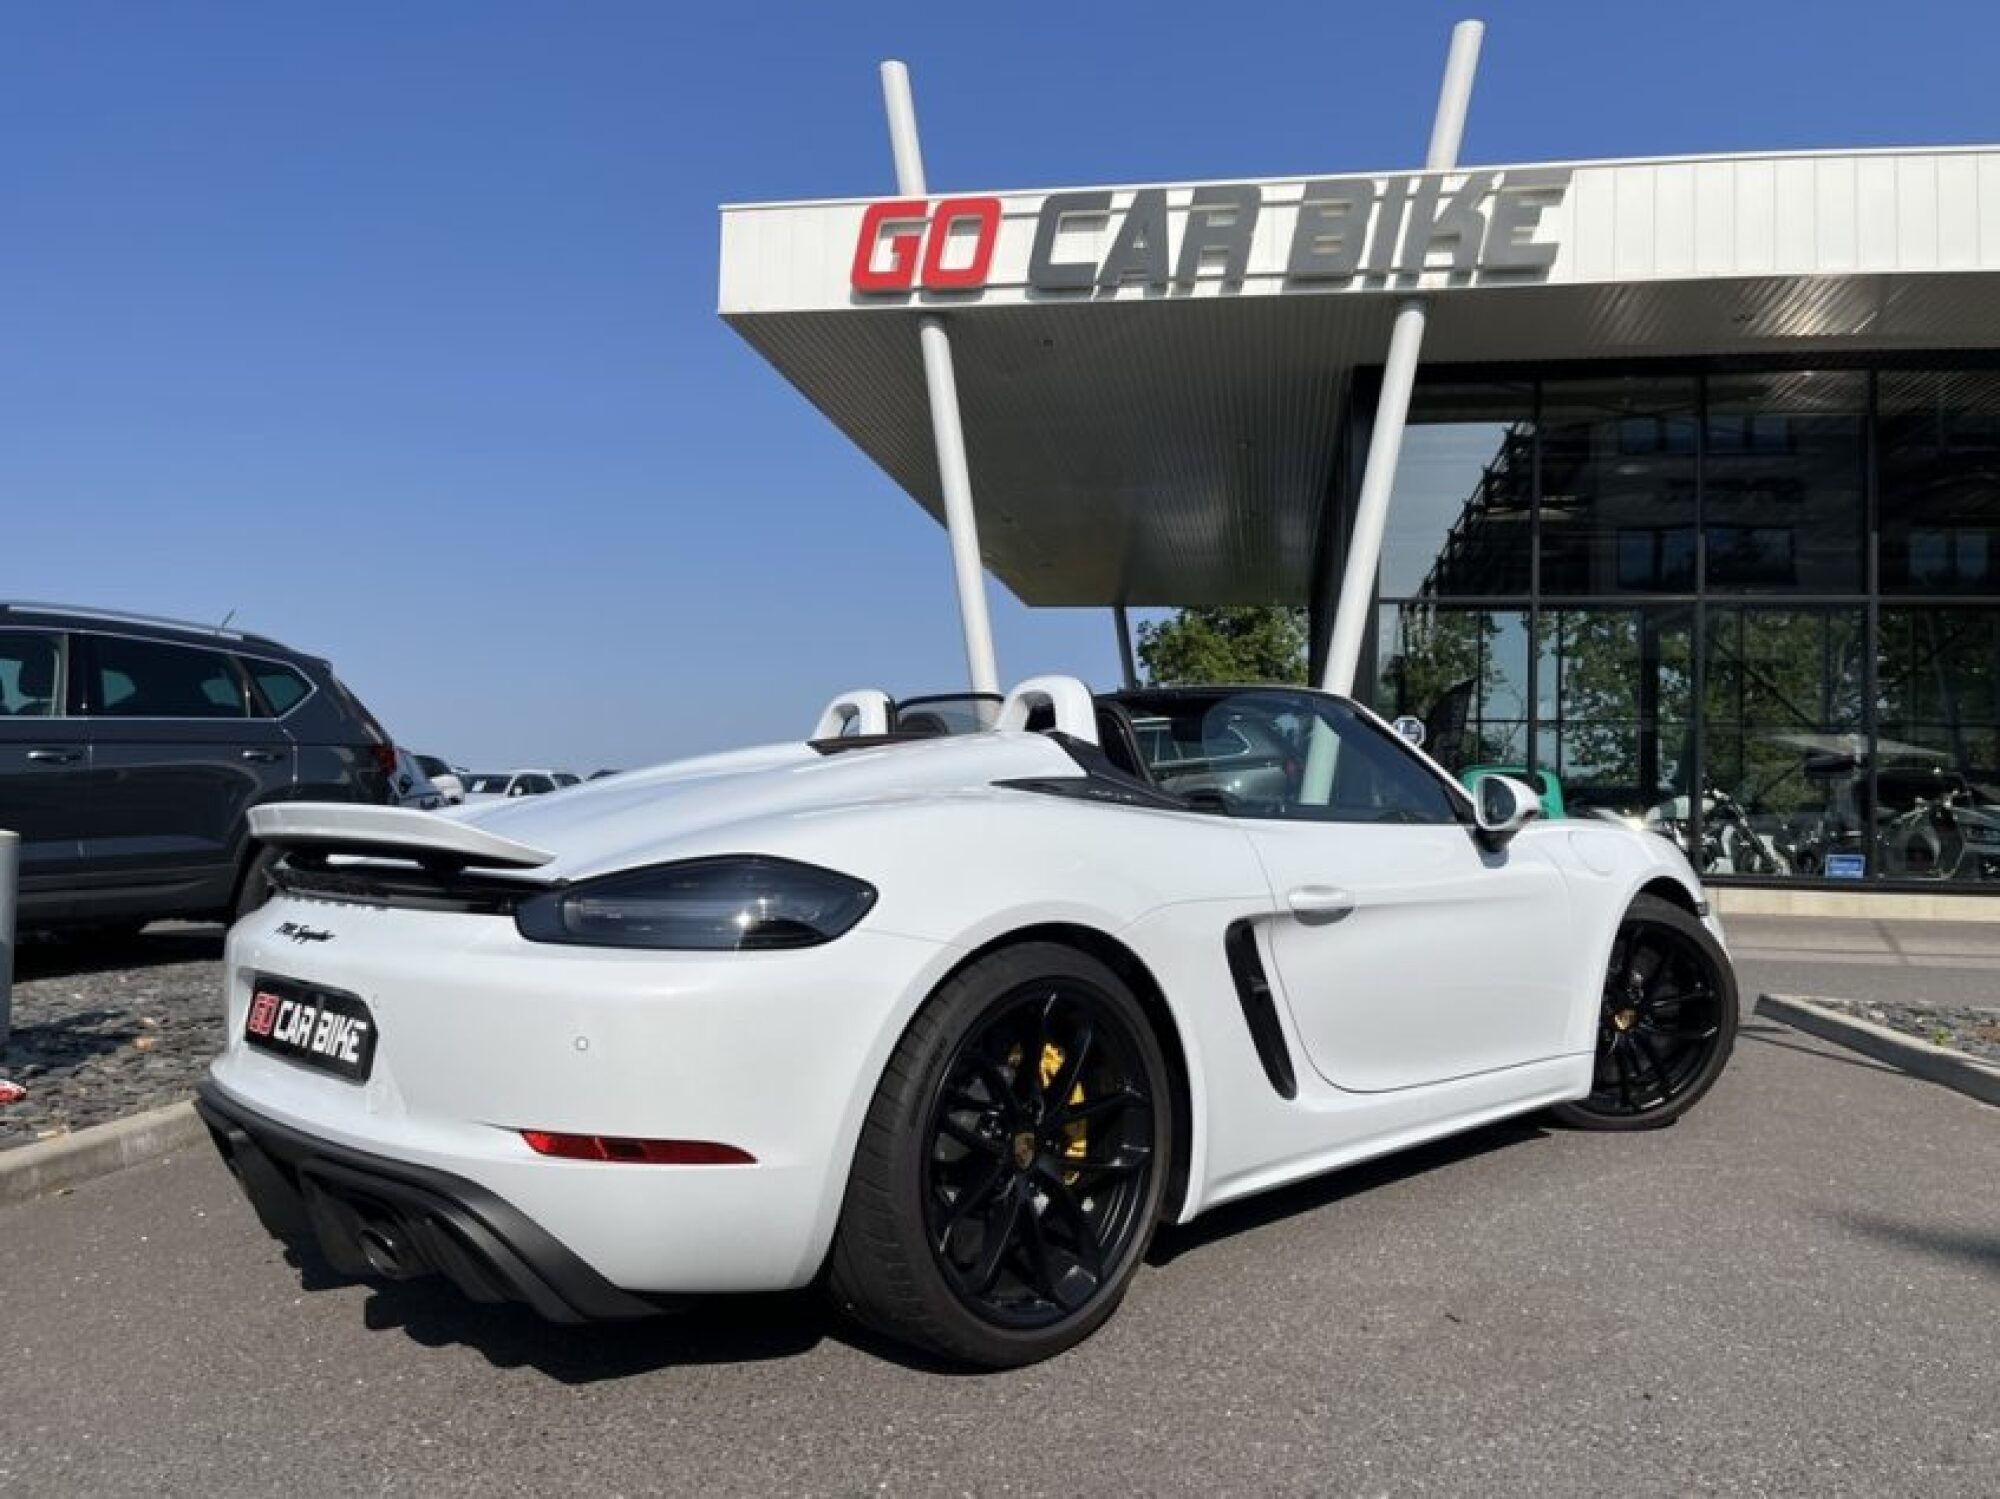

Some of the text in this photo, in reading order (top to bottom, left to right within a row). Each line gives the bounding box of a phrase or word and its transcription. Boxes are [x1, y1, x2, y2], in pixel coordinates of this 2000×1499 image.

[850, 168, 1575, 296] GO CAR BIKE
[249, 991, 369, 1064] GO CAR BIKE
